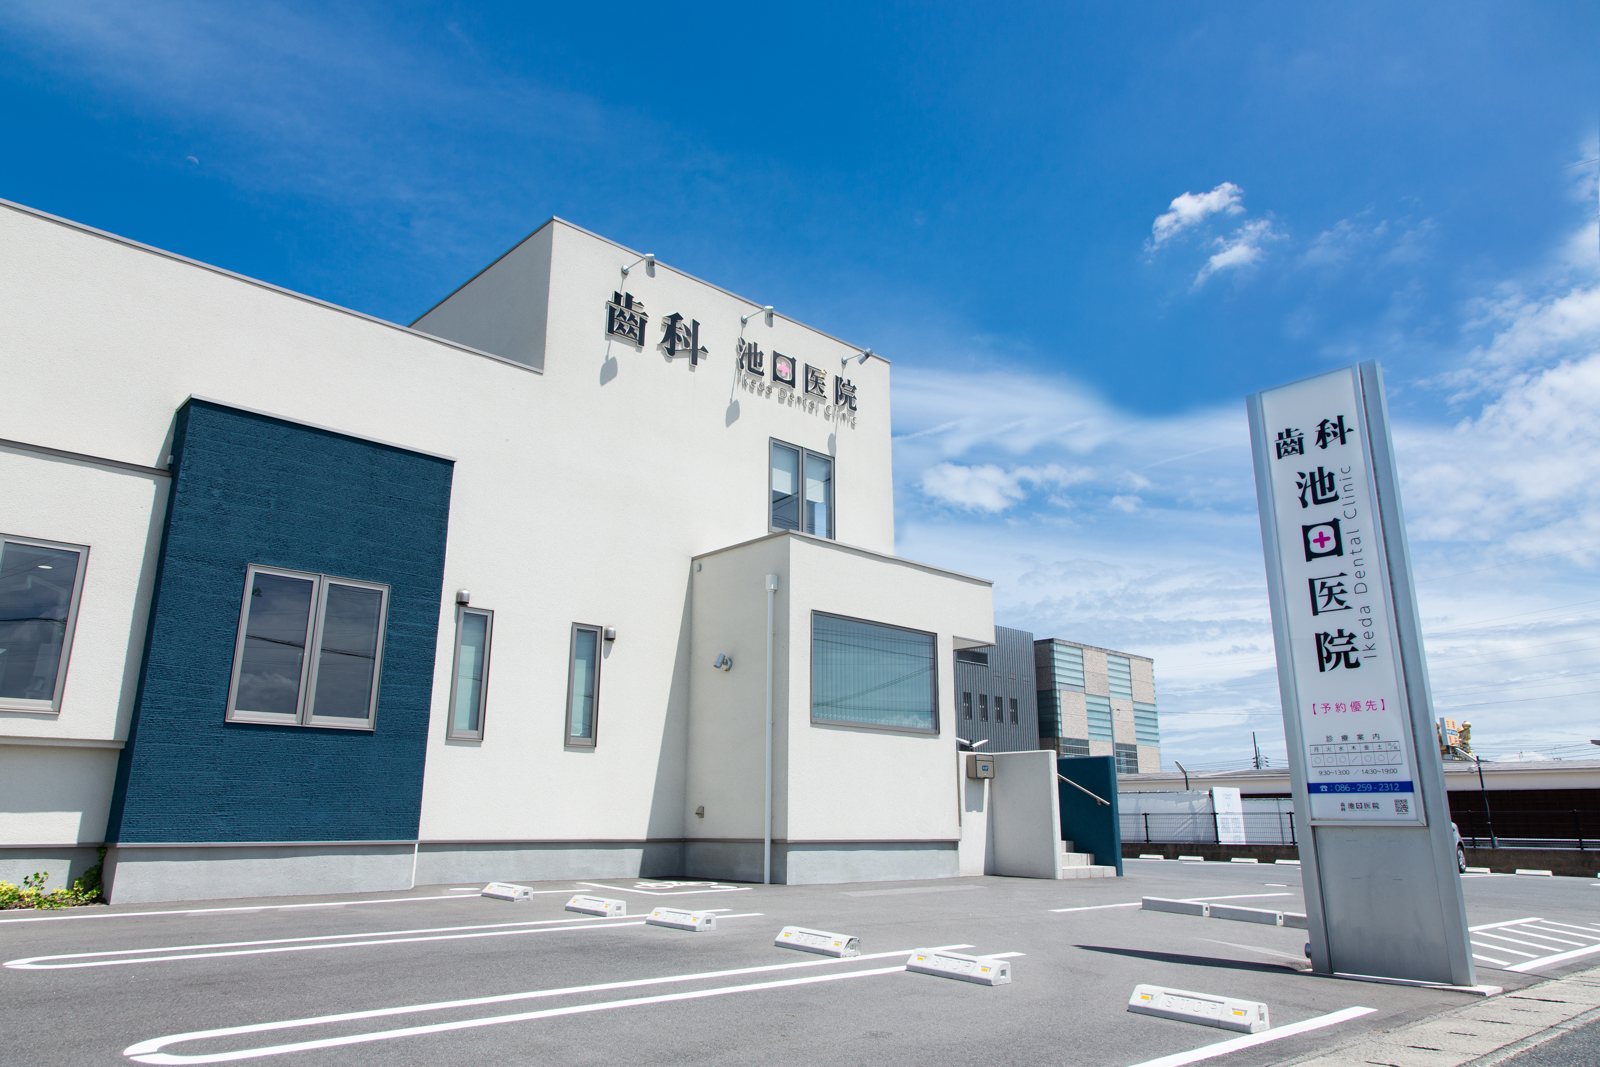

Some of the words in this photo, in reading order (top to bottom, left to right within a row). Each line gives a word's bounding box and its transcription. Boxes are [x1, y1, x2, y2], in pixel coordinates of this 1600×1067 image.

[736, 371, 773, 395] Ikeda
[778, 387, 819, 412] Dental
[1338, 465, 1358, 520] Clinic
[1345, 529, 1368, 595] Dental
[1358, 605, 1377, 659] Ikeda
[933, 957, 972, 972] STOP
[1165, 996, 1218, 1015] STOP
